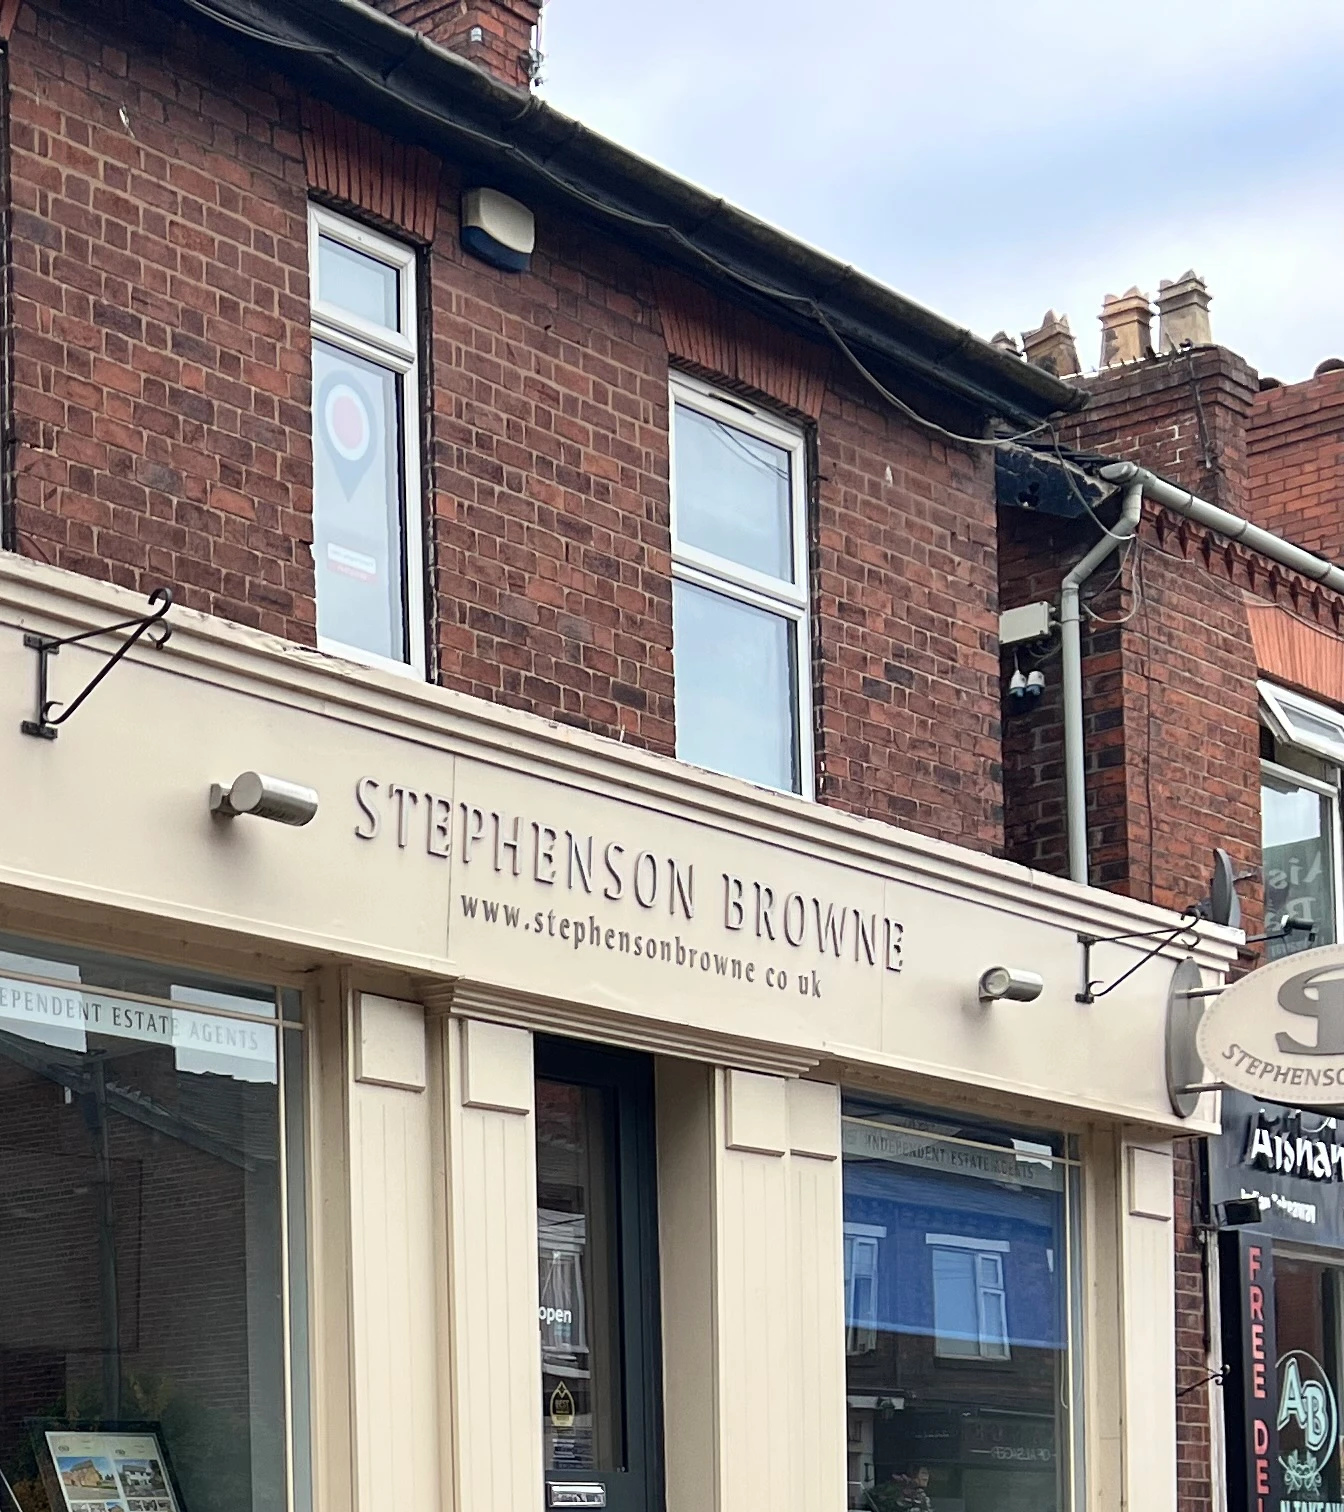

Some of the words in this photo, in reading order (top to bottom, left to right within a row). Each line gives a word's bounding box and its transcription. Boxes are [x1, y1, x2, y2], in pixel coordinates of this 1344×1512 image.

[355, 775, 694, 920] STEPHENSON
[722, 873, 905, 974] BROWNE
[112, 1007, 180, 1037] ESTATE
[189, 1020, 259, 1051] AGENTS
[951, 1150, 989, 1170] ESTATE
[539, 1305, 572, 1325] open
[1248, 1246, 1266, 1399] FREE
